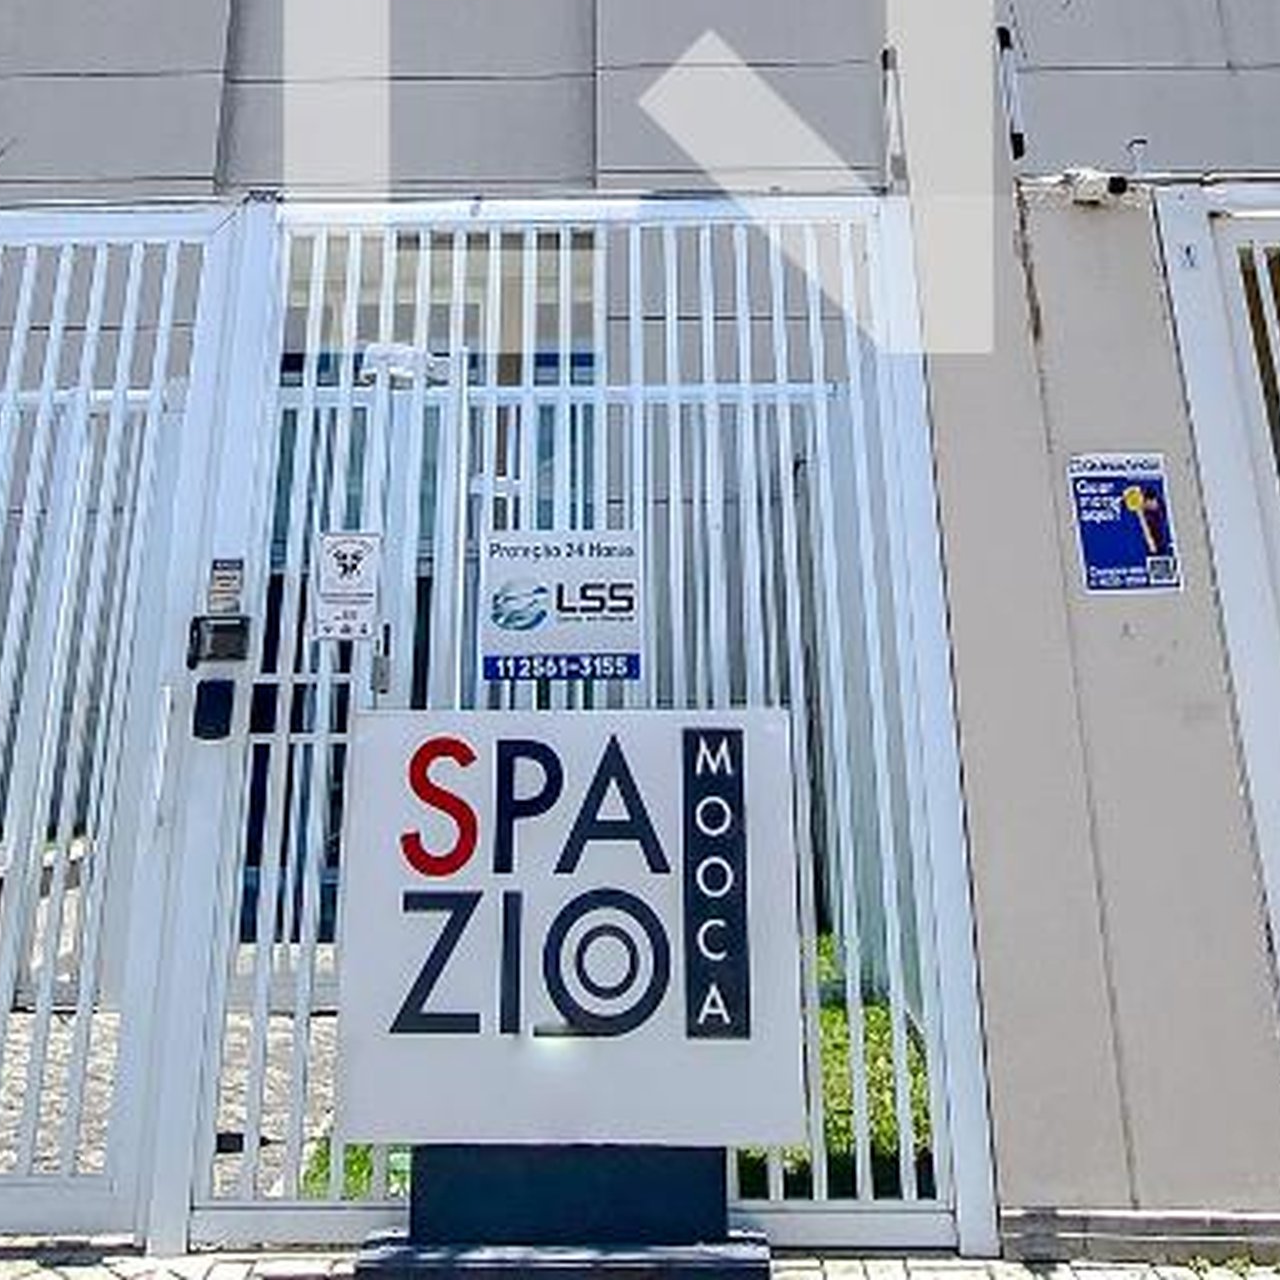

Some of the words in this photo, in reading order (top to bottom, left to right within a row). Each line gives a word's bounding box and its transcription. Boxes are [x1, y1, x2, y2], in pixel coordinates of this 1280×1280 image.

[556, 582, 635, 613] LSS
[400, 734, 671, 877] SPA
[694, 736, 734, 1024] MOOCA
